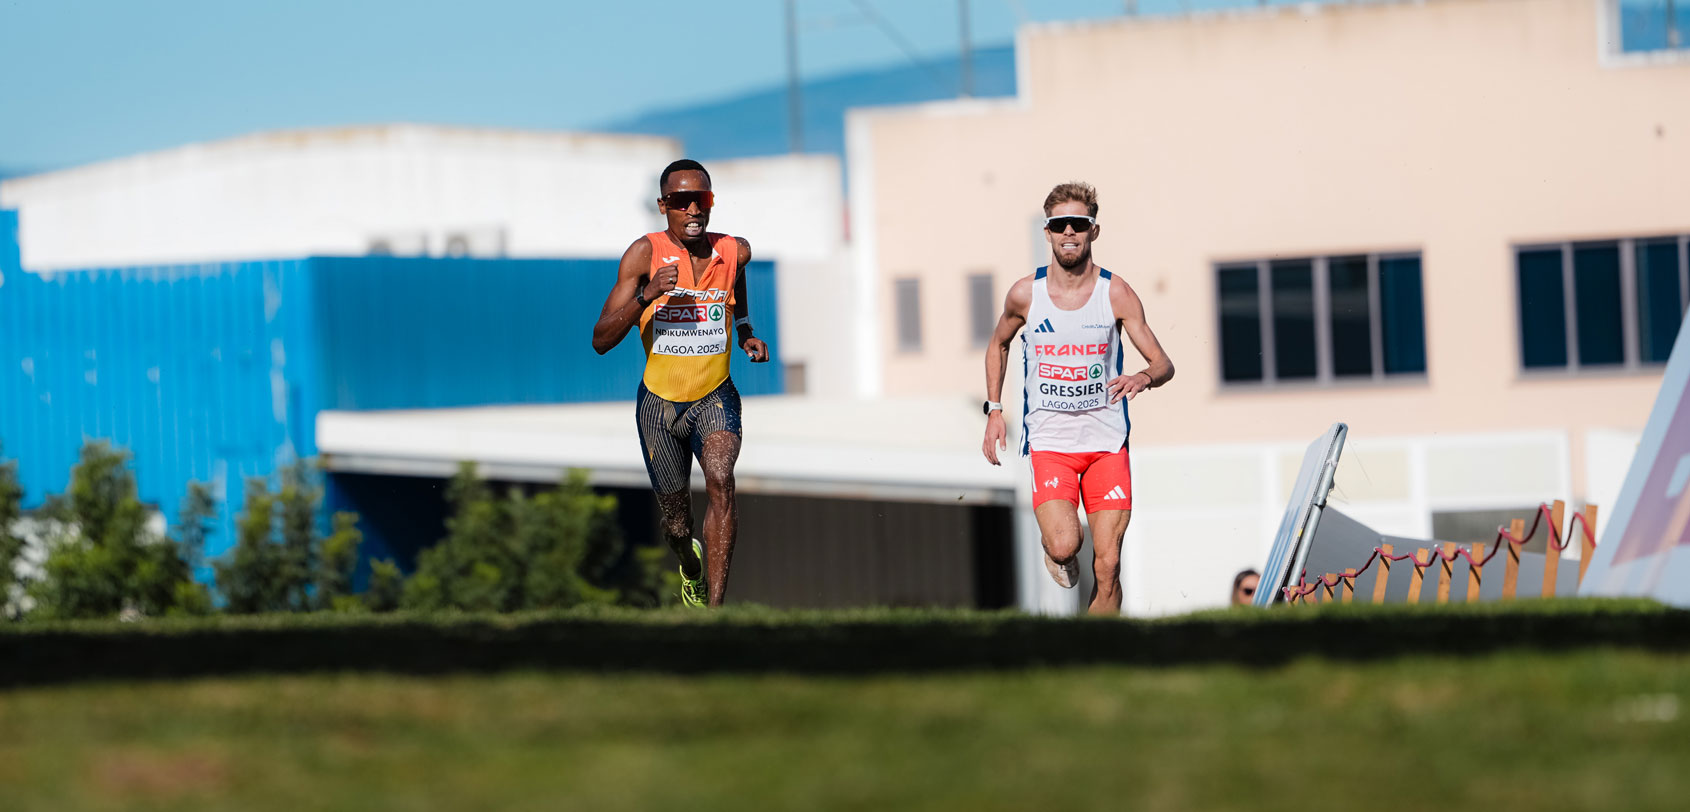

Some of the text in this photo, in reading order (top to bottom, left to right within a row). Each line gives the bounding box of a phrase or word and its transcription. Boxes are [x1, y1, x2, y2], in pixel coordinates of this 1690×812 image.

[656, 308, 706, 320] SPAR
[655, 328, 724, 337] NDIKUMWENAYO
[658, 344, 720, 354] LAGOA 2025
[1035, 343, 1108, 356] FRANCE
[1040, 365, 1087, 380] SPAR
[1039, 382, 1104, 397] GRESSIER
[1042, 399, 1099, 410] LAGOA 2025
